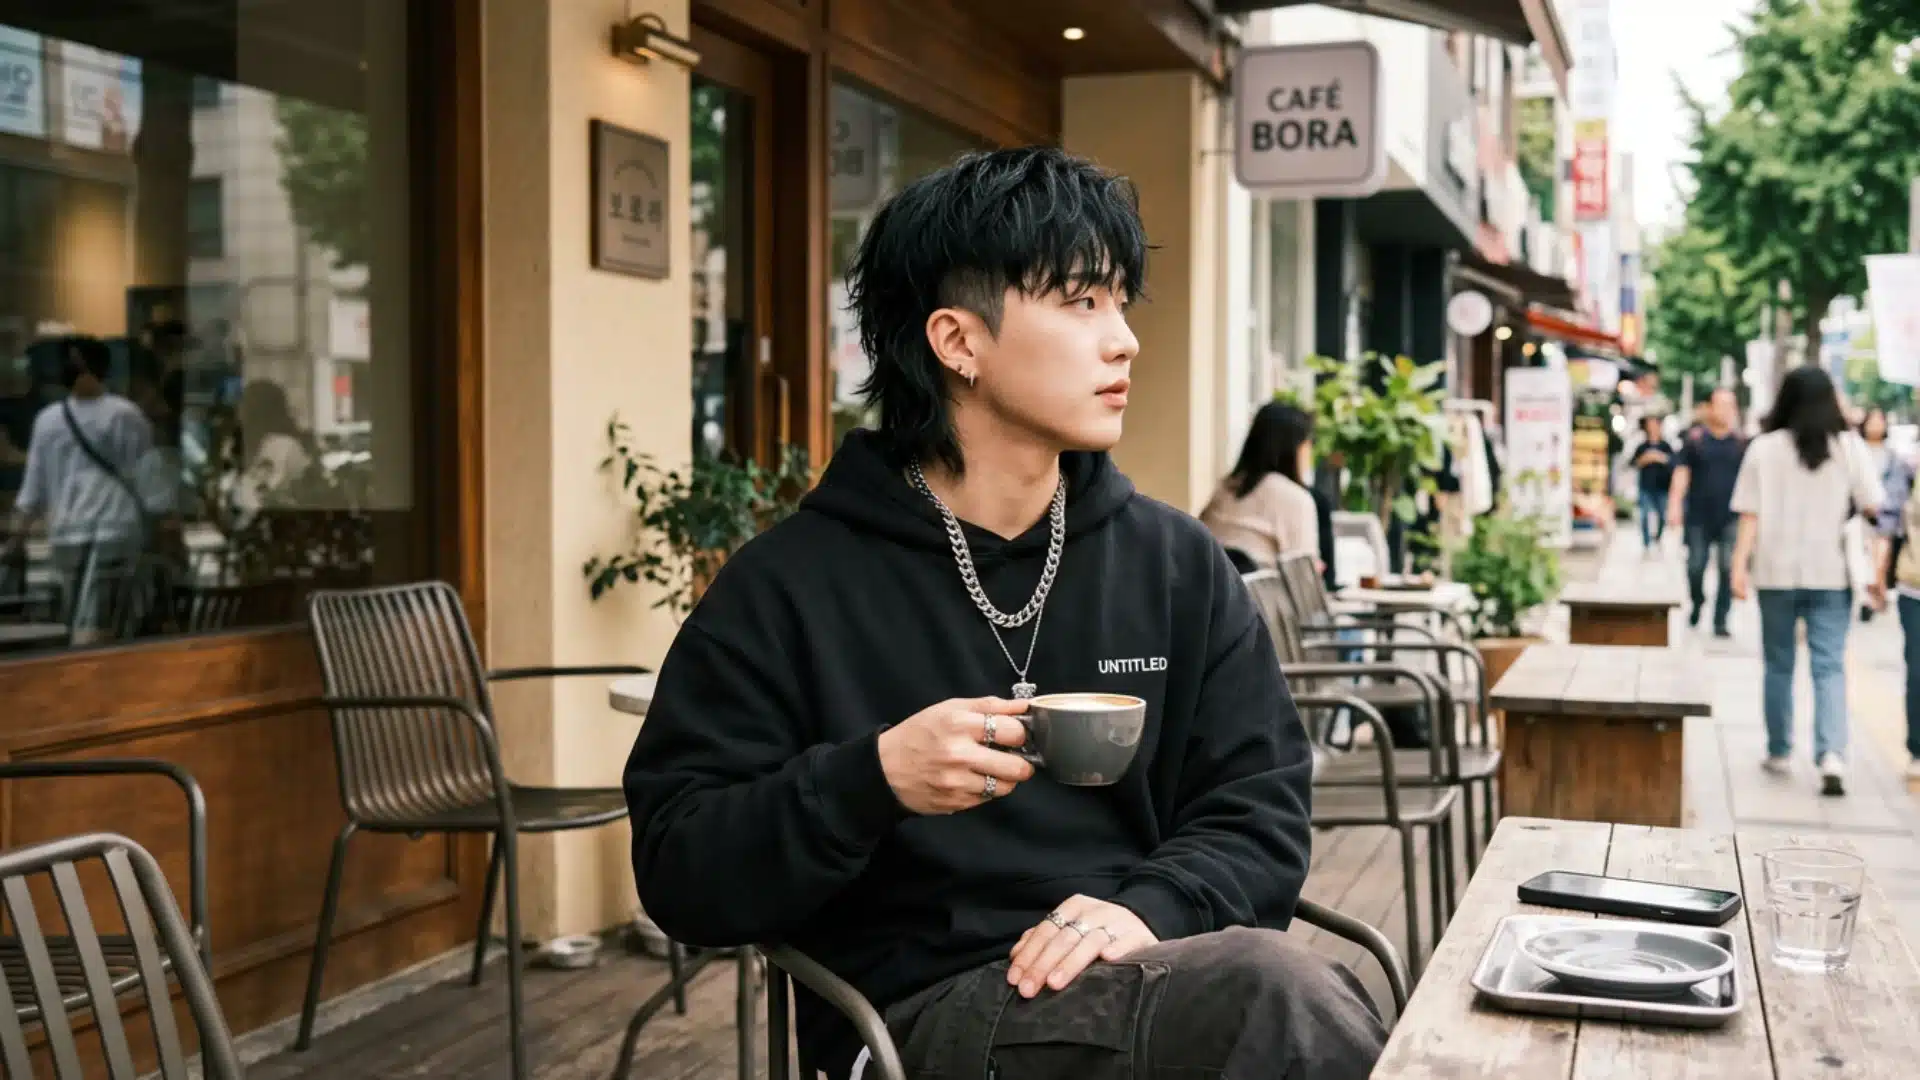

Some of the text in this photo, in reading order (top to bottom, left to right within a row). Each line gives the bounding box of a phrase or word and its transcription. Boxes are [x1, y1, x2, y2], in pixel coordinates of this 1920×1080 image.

[1268, 78, 1342, 113] CAFÉ
[1252, 117, 1358, 151] BORA
[1098, 657, 1168, 673] UNTITLED
